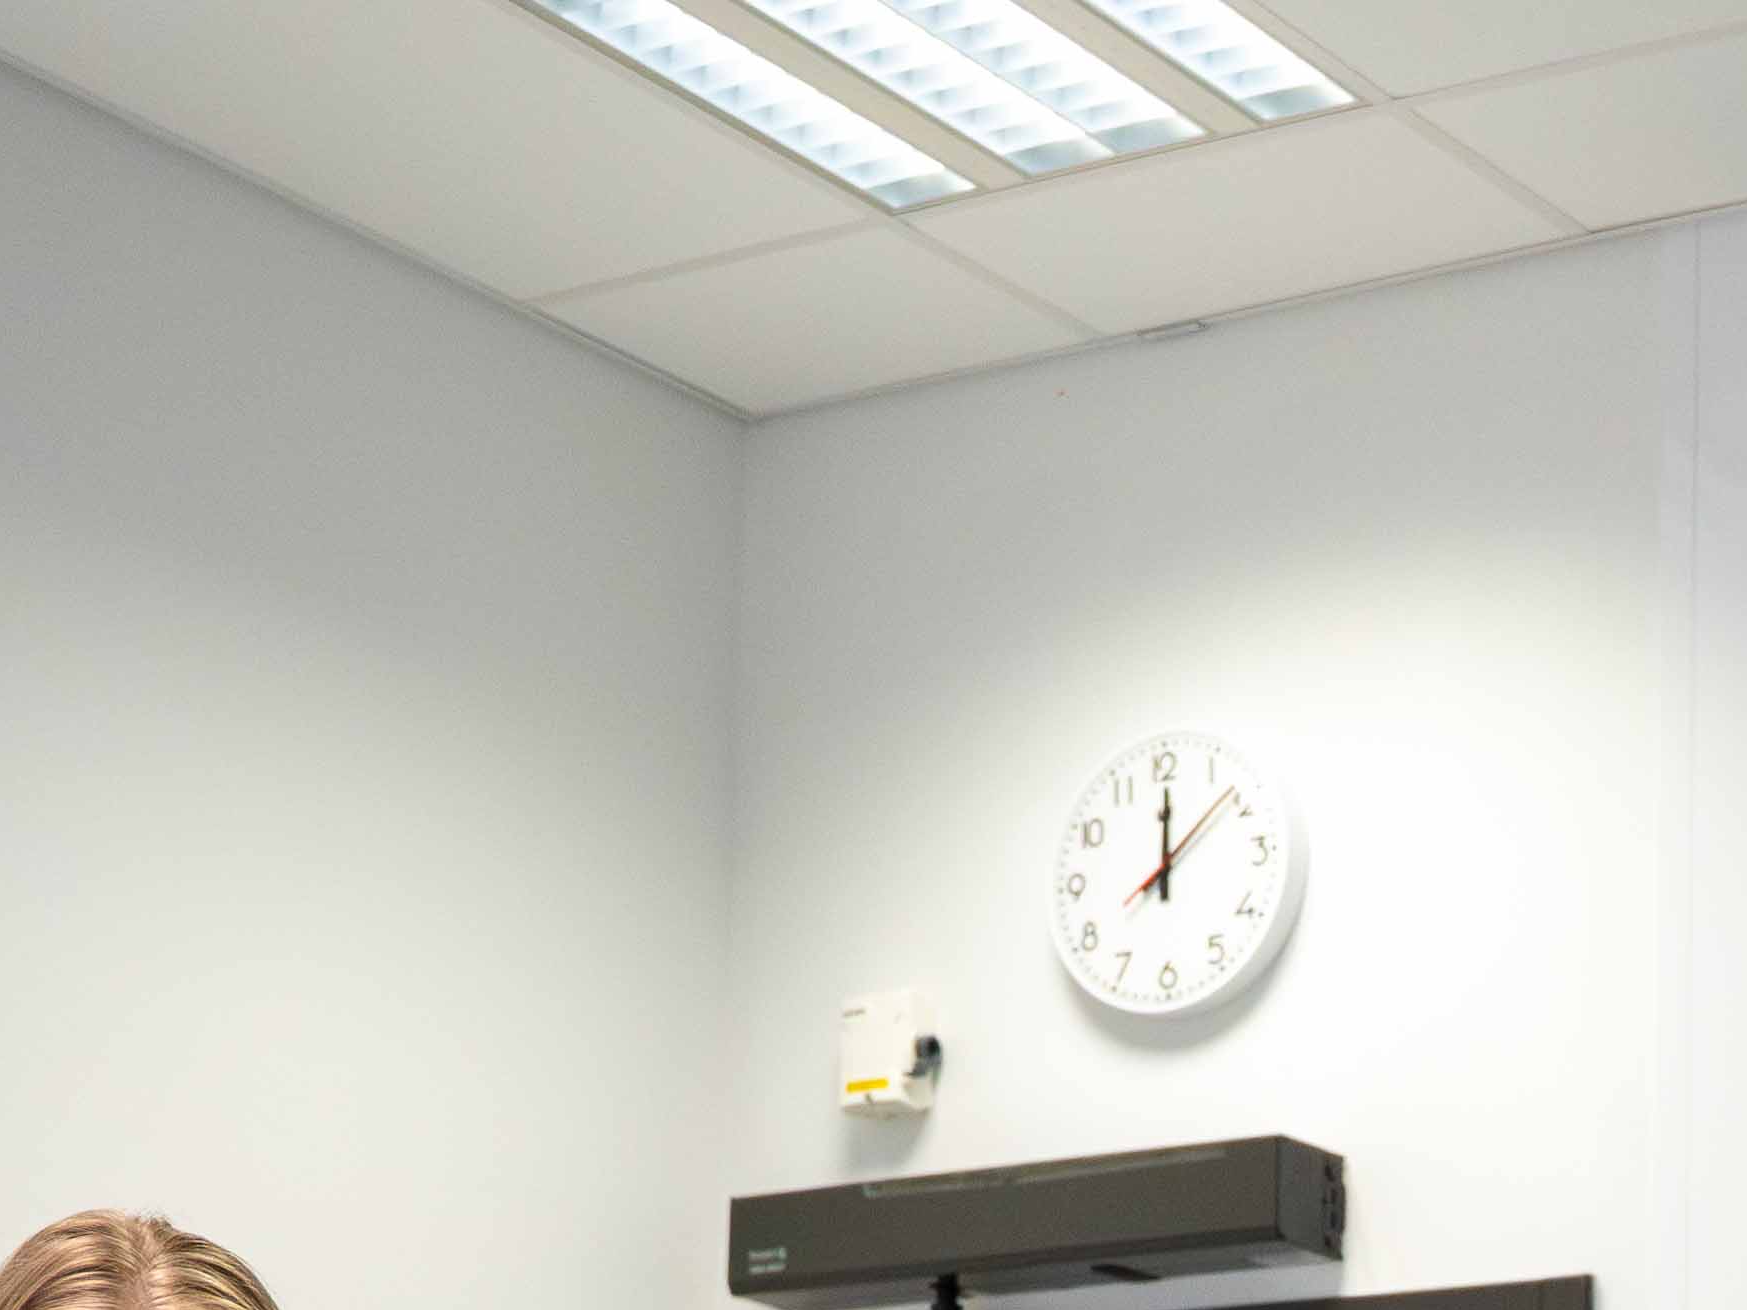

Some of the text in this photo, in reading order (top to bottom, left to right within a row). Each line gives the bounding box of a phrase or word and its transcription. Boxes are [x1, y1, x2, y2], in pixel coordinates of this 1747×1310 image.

[1152, 752, 1176, 782] 12
[1208, 756, 1215, 783] 1
[1115, 776, 1133, 806] 11
[1082, 818, 1103, 848] 10
[1251, 836, 1268, 866] 3
[1067, 873, 1086, 899] 9
[1235, 891, 1255, 918] 4
[1082, 921, 1098, 952] 8
[1208, 934, 1226, 965] 5
[1115, 952, 1133, 986] 7
[1158, 961, 1177, 990] 6
